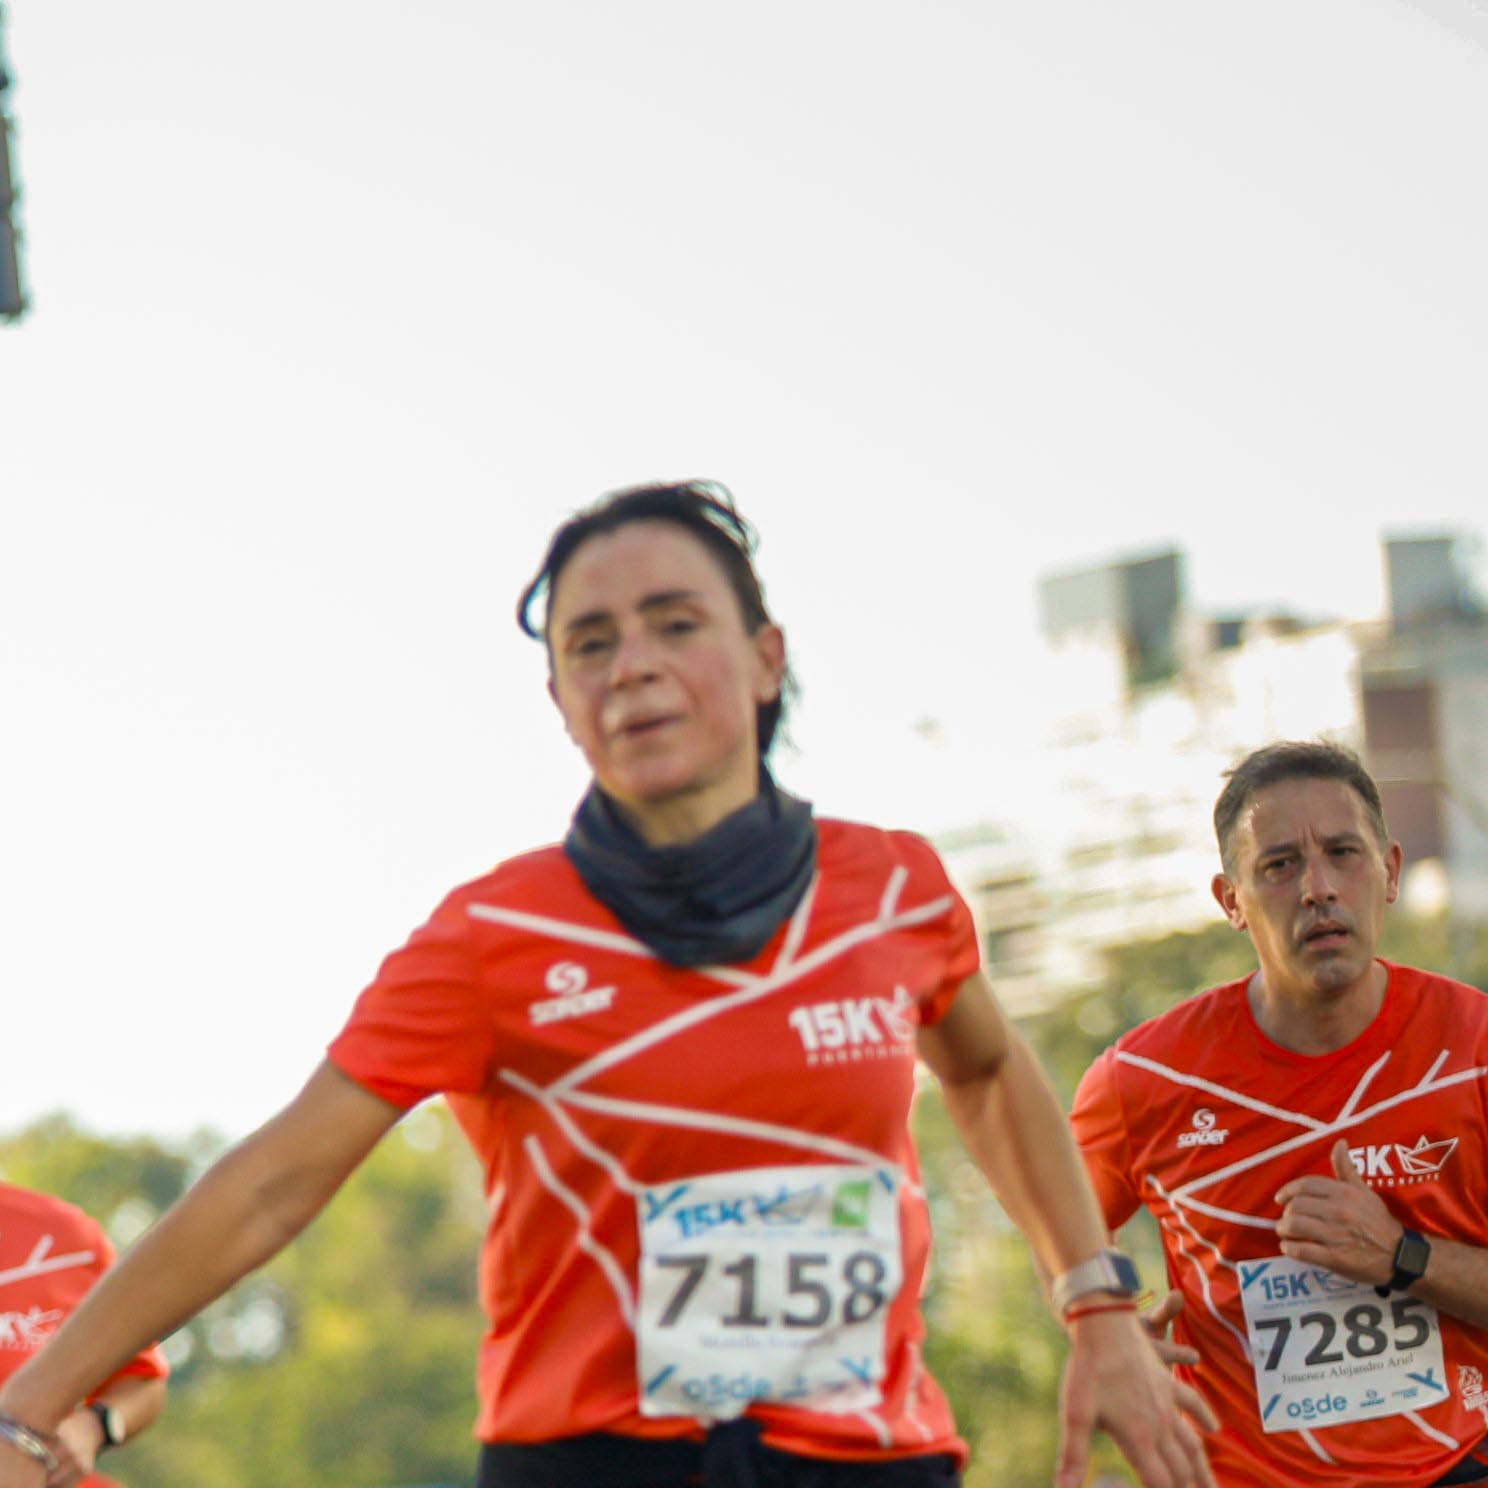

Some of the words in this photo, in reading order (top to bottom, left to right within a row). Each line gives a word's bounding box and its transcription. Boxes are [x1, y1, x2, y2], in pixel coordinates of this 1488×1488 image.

[788, 997, 883, 1051] 15K
[1347, 1144, 1394, 1176] 5K
[656, 1251, 886, 1328] 7158
[1260, 1271, 1311, 1300] 15K
[1254, 1297, 1431, 1371] 7285
[1287, 1393, 1348, 1420] osde
